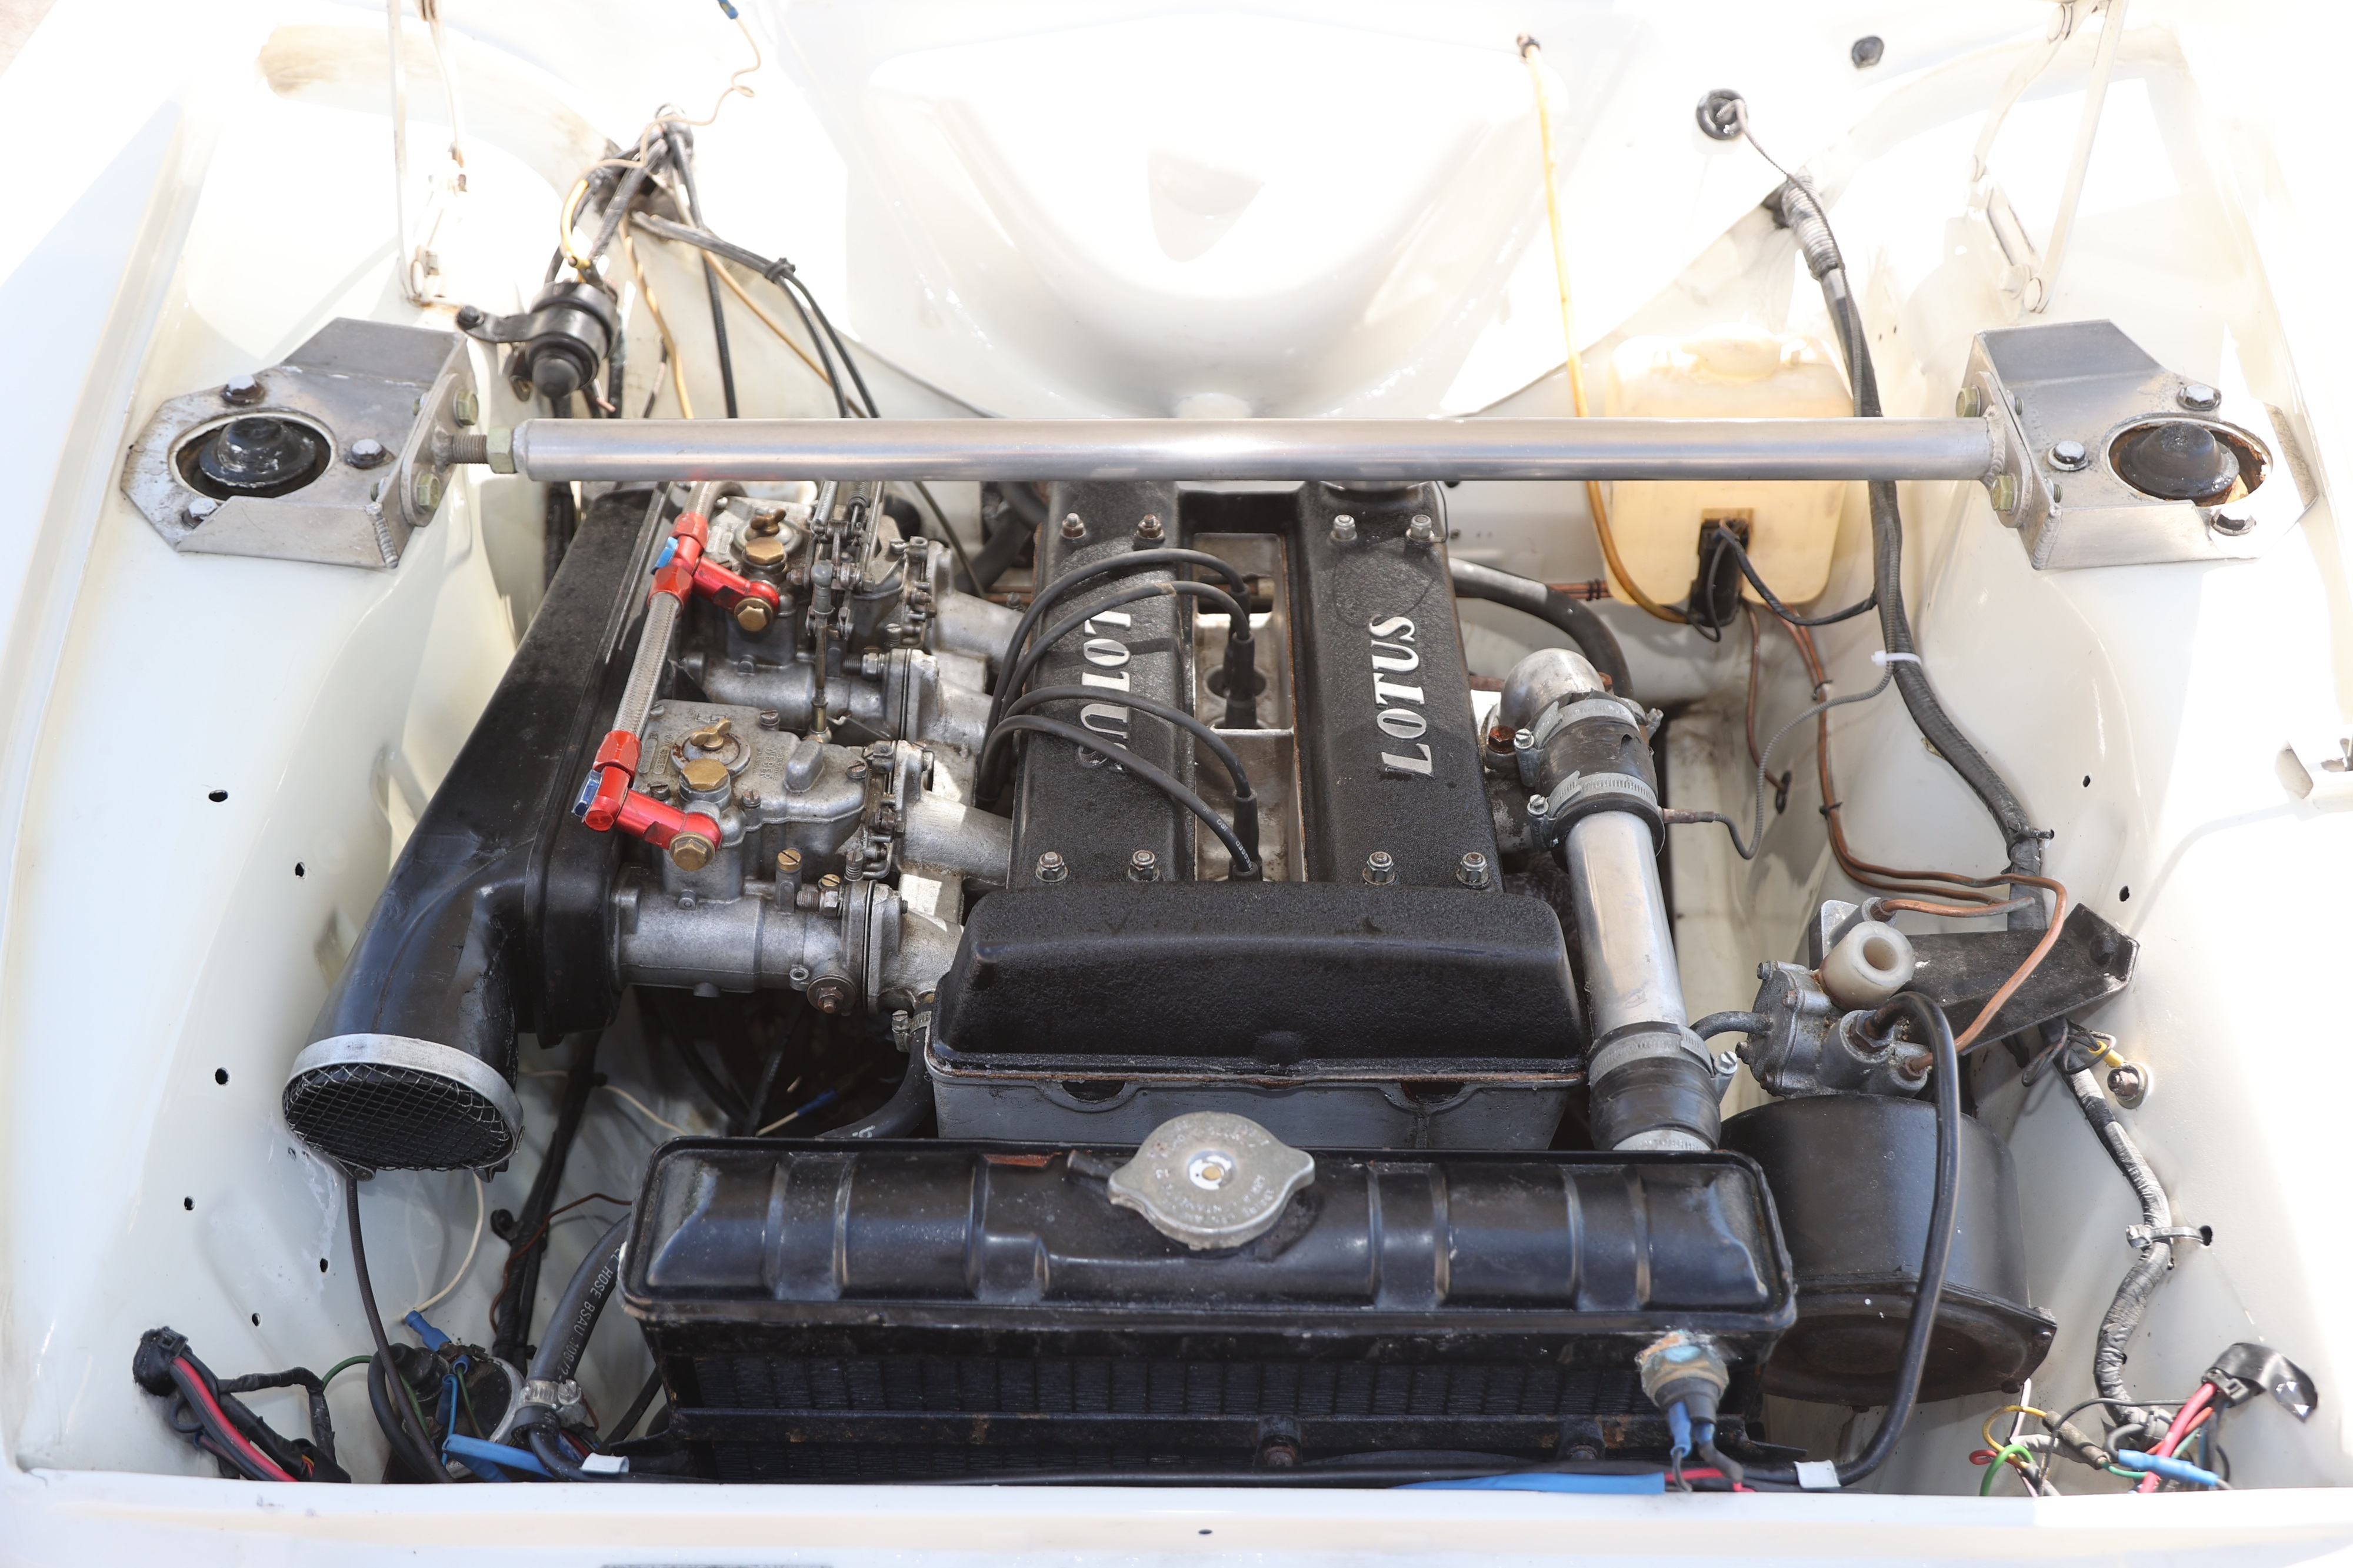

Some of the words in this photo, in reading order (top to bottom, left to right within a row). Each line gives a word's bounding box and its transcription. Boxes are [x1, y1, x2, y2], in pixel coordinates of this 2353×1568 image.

[1369, 615, 1434, 775] LOTUS
[760, 746, 776, 779] WEBER
[1217, 819, 1229, 832] ISO
[1235, 840, 1253, 870] RESSED
[590, 1265, 613, 1299] HOSE
